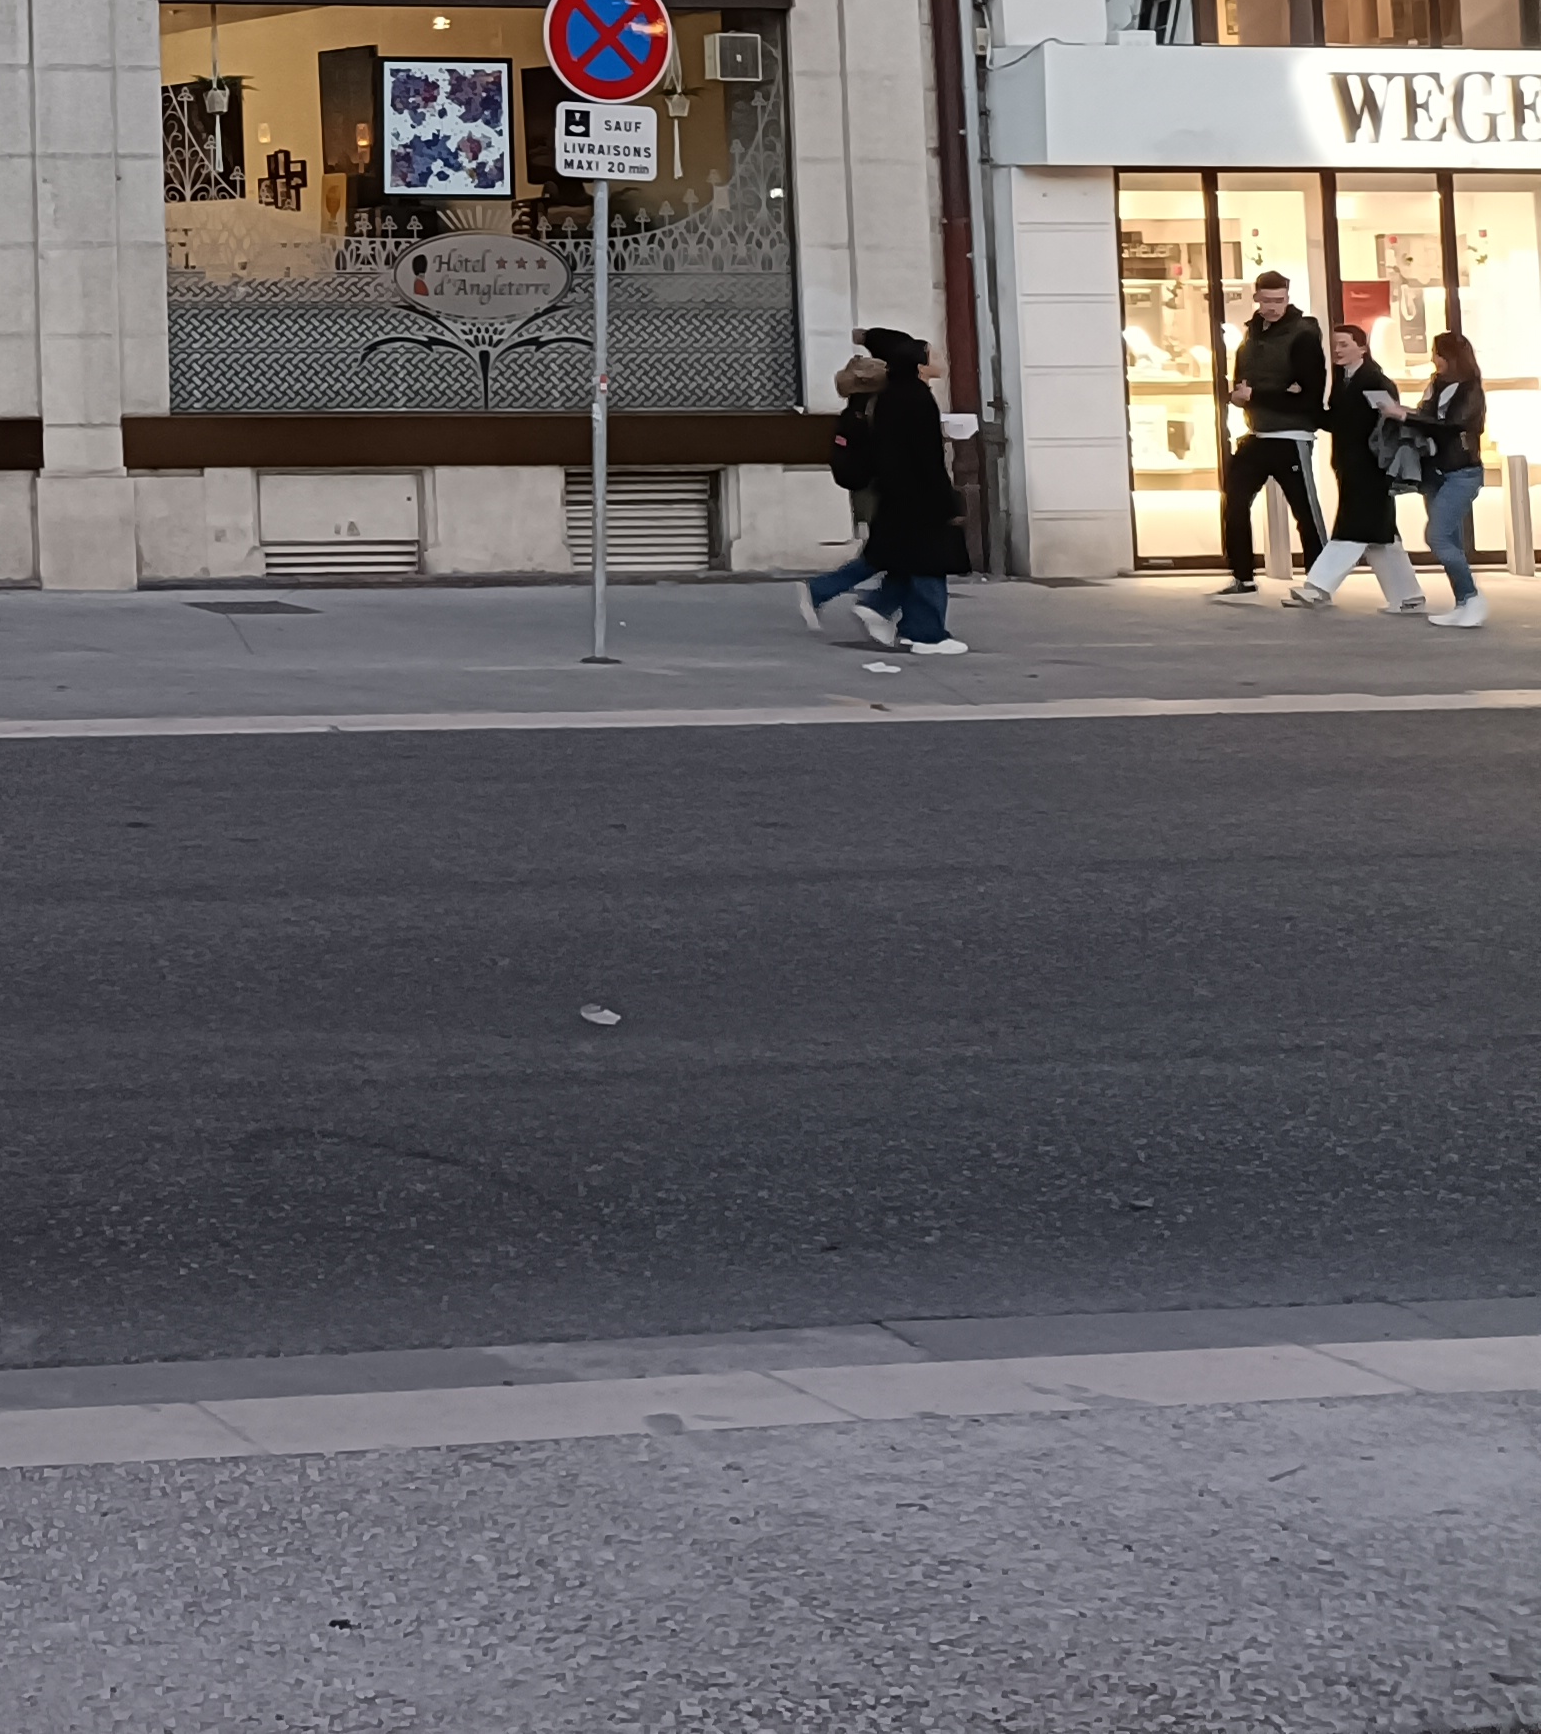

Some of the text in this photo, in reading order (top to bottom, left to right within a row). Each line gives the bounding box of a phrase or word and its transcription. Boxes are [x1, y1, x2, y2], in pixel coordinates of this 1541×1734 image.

[604, 119, 643, 132] SAUF
[563, 142, 652, 159] LIVRAISONS
[563, 158, 650, 175] MAXI 20 min
[433, 248, 492, 273] Hôtel
[433, 274, 551, 306] d'Angleterre
